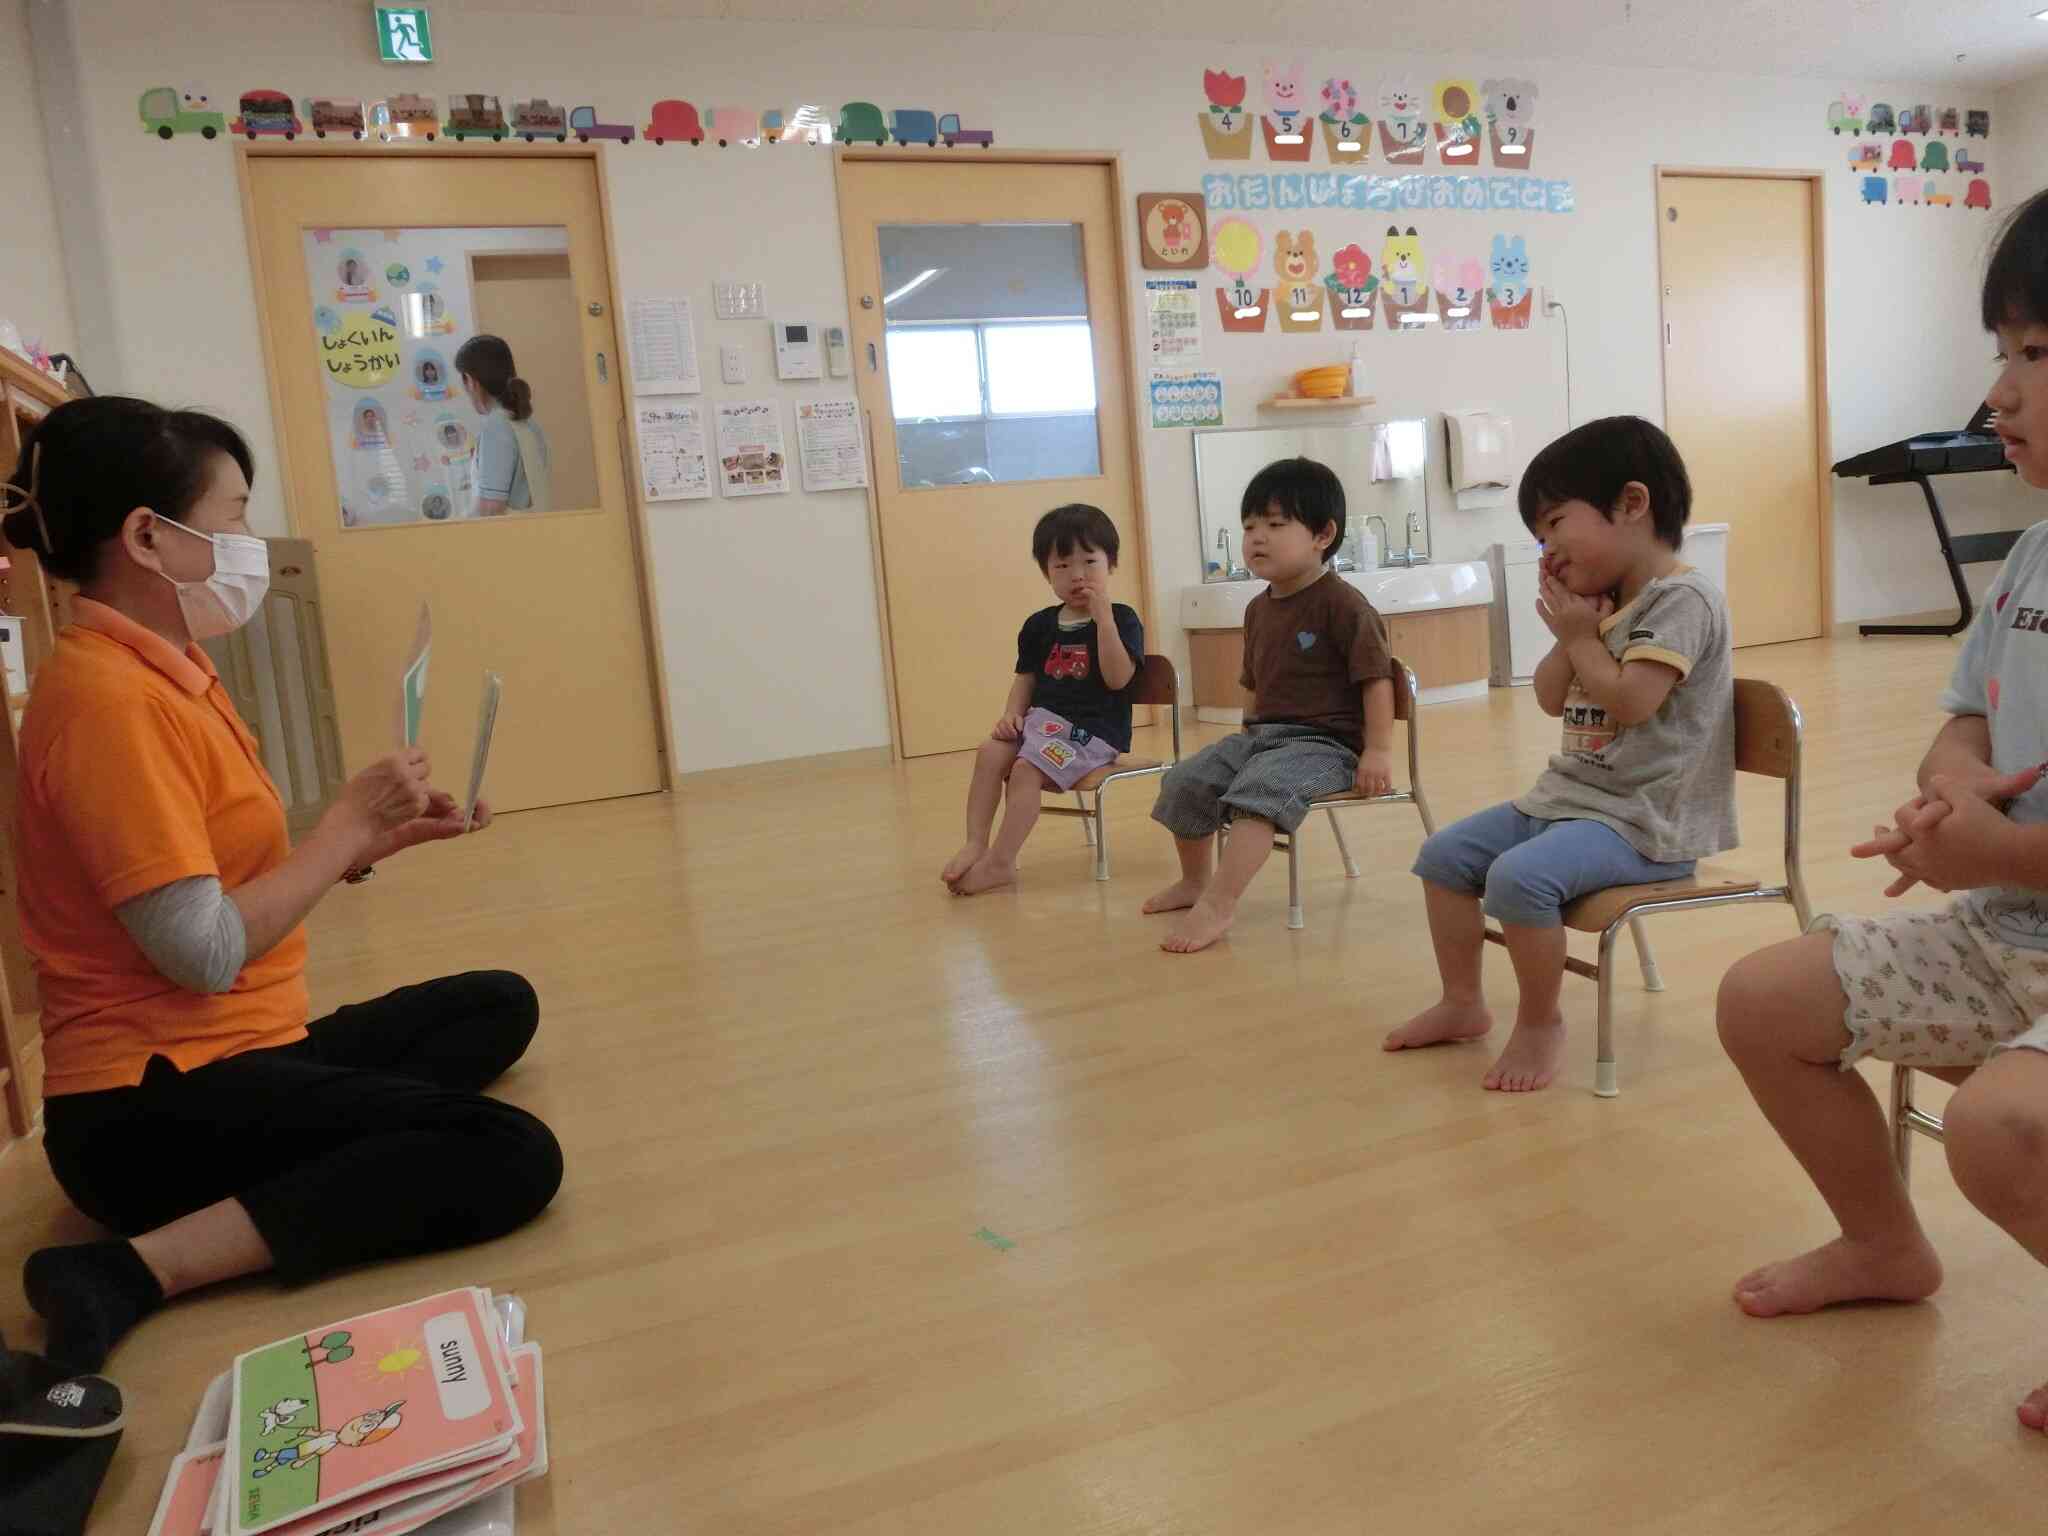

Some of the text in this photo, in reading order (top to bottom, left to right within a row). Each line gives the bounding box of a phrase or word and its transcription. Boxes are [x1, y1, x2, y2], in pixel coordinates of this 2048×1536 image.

[1221, 113, 1233, 131] 4
[1282, 116, 1293, 133] 5
[1340, 120, 1351, 138] 6
[1396, 122, 1407, 139] 7
[1506, 127, 1517, 143] 9
[1234, 288, 1253, 306] 10
[1292, 287, 1307, 305] 11
[1345, 287, 1362, 305] 12
[1400, 287, 1409, 304] 1
[1455, 287, 1467, 301] 2
[1504, 288, 1515, 305] 3
[322, 327, 394, 350] しょくいん
[326, 352, 401, 373] しょうかい
[440, 1340, 467, 1384] sunny
